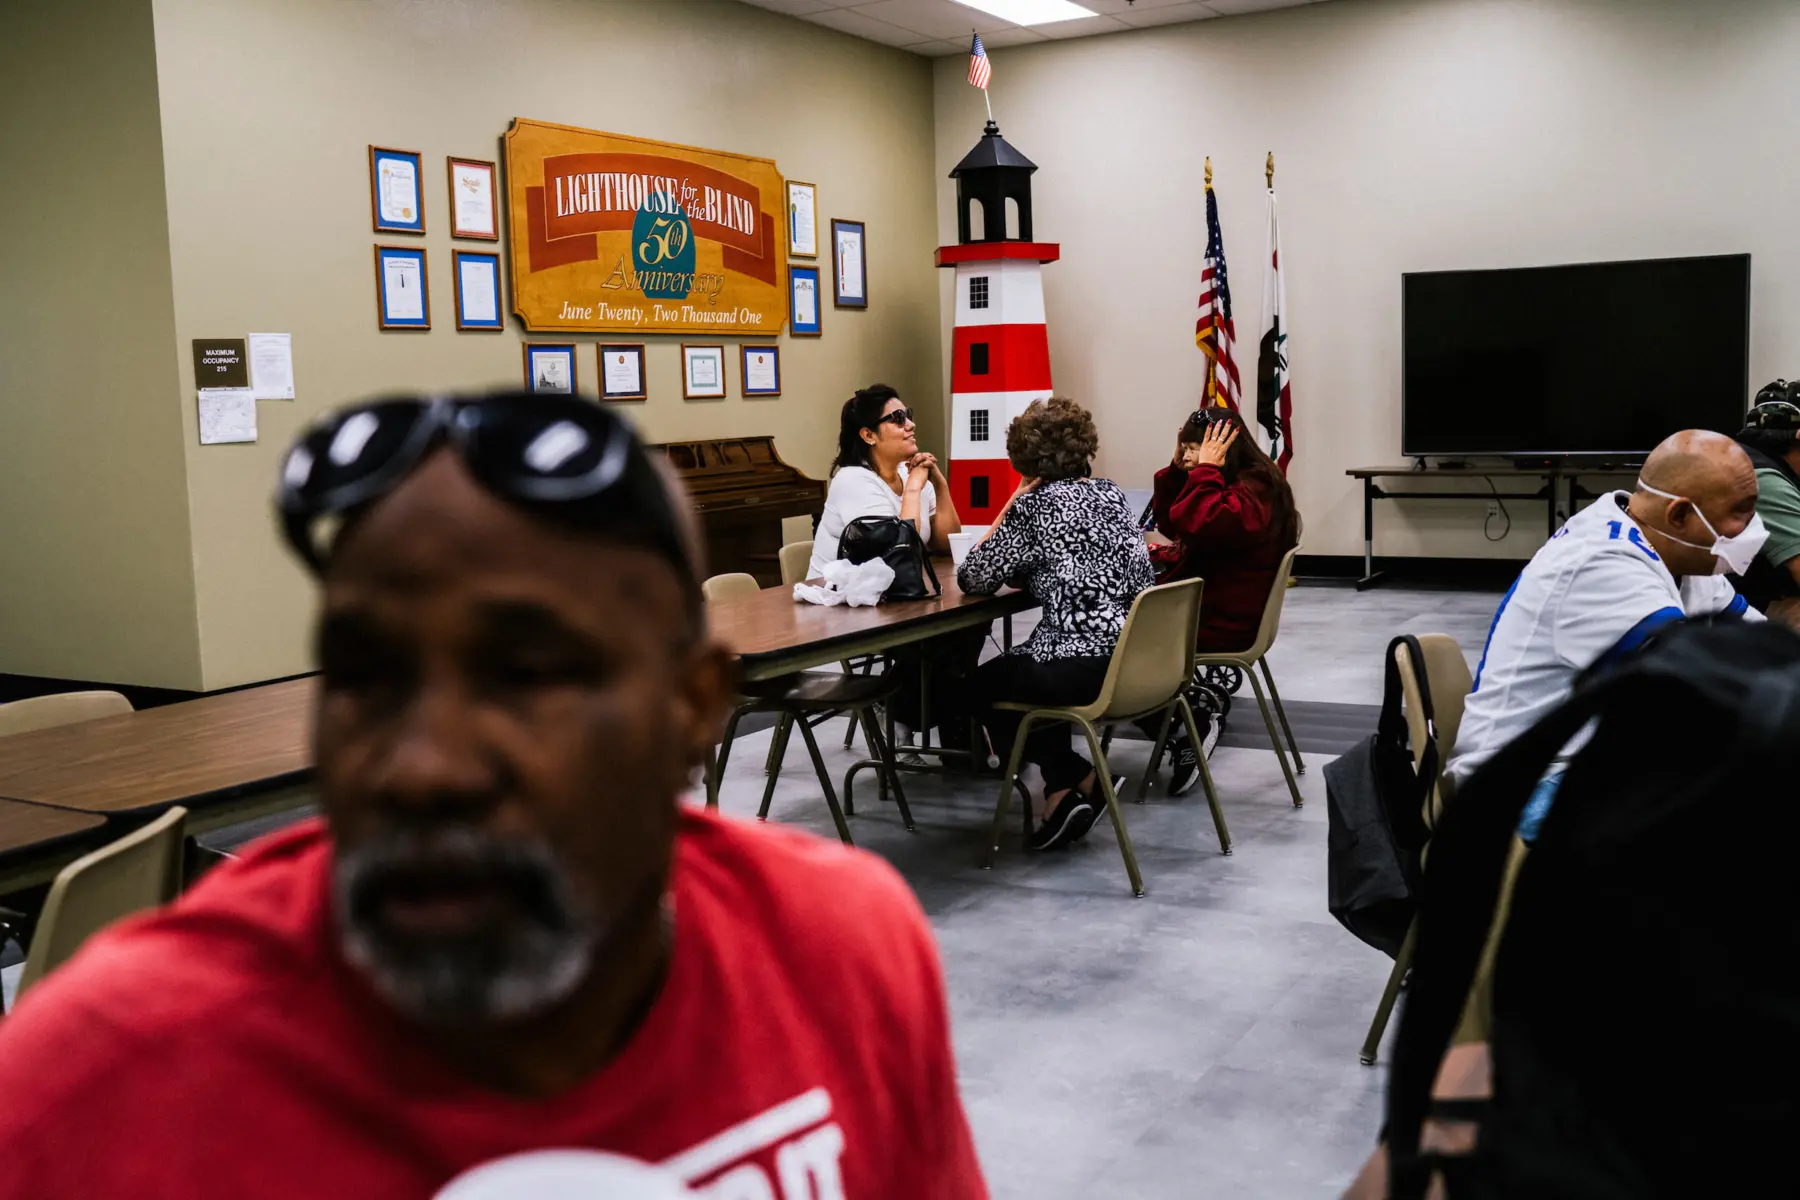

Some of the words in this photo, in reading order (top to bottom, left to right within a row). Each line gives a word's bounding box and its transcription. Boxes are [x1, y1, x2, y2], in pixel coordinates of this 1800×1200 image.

[555, 172, 680, 218] LIGHTHOUSE
[678, 177, 698, 207] for
[687, 198, 706, 221] the
[704, 184, 755, 236] BLIND
[601, 253, 725, 305] Anniversary
[559, 301, 592, 320] June
[653, 304, 679, 323] Two
[681, 305, 738, 324] Thousand
[739, 307, 763, 325] One
